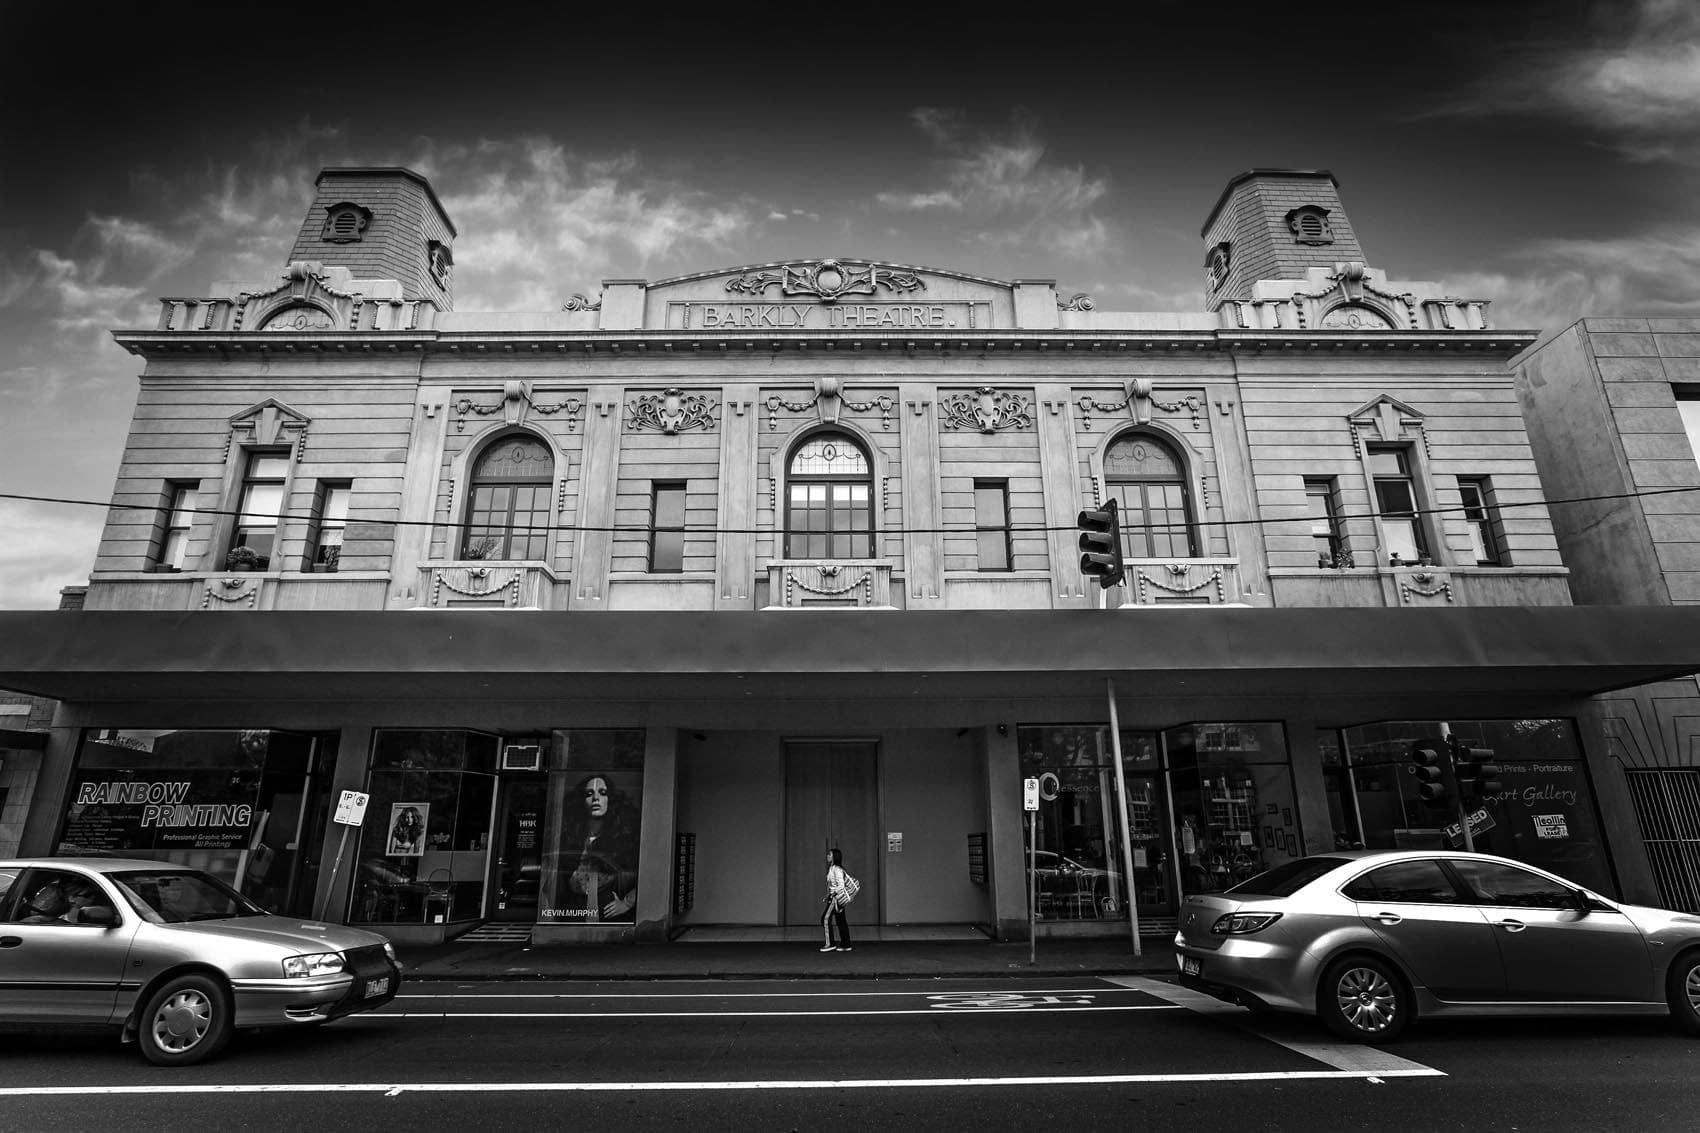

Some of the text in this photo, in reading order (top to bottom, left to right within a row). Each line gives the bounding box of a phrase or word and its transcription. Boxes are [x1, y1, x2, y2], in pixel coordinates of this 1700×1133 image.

[703, 306, 812, 327] BARKLY
[1503, 764, 1527, 773] Prints
[77, 782, 192, 805] RAINBOW
[1522, 784, 1577, 807] Gallery
[140, 804, 252, 828] PRINTING
[1446, 809, 1488, 838] LESED
[221, 833, 242, 841] Service
[541, 909, 599, 917] KEVIN.MURPHY
